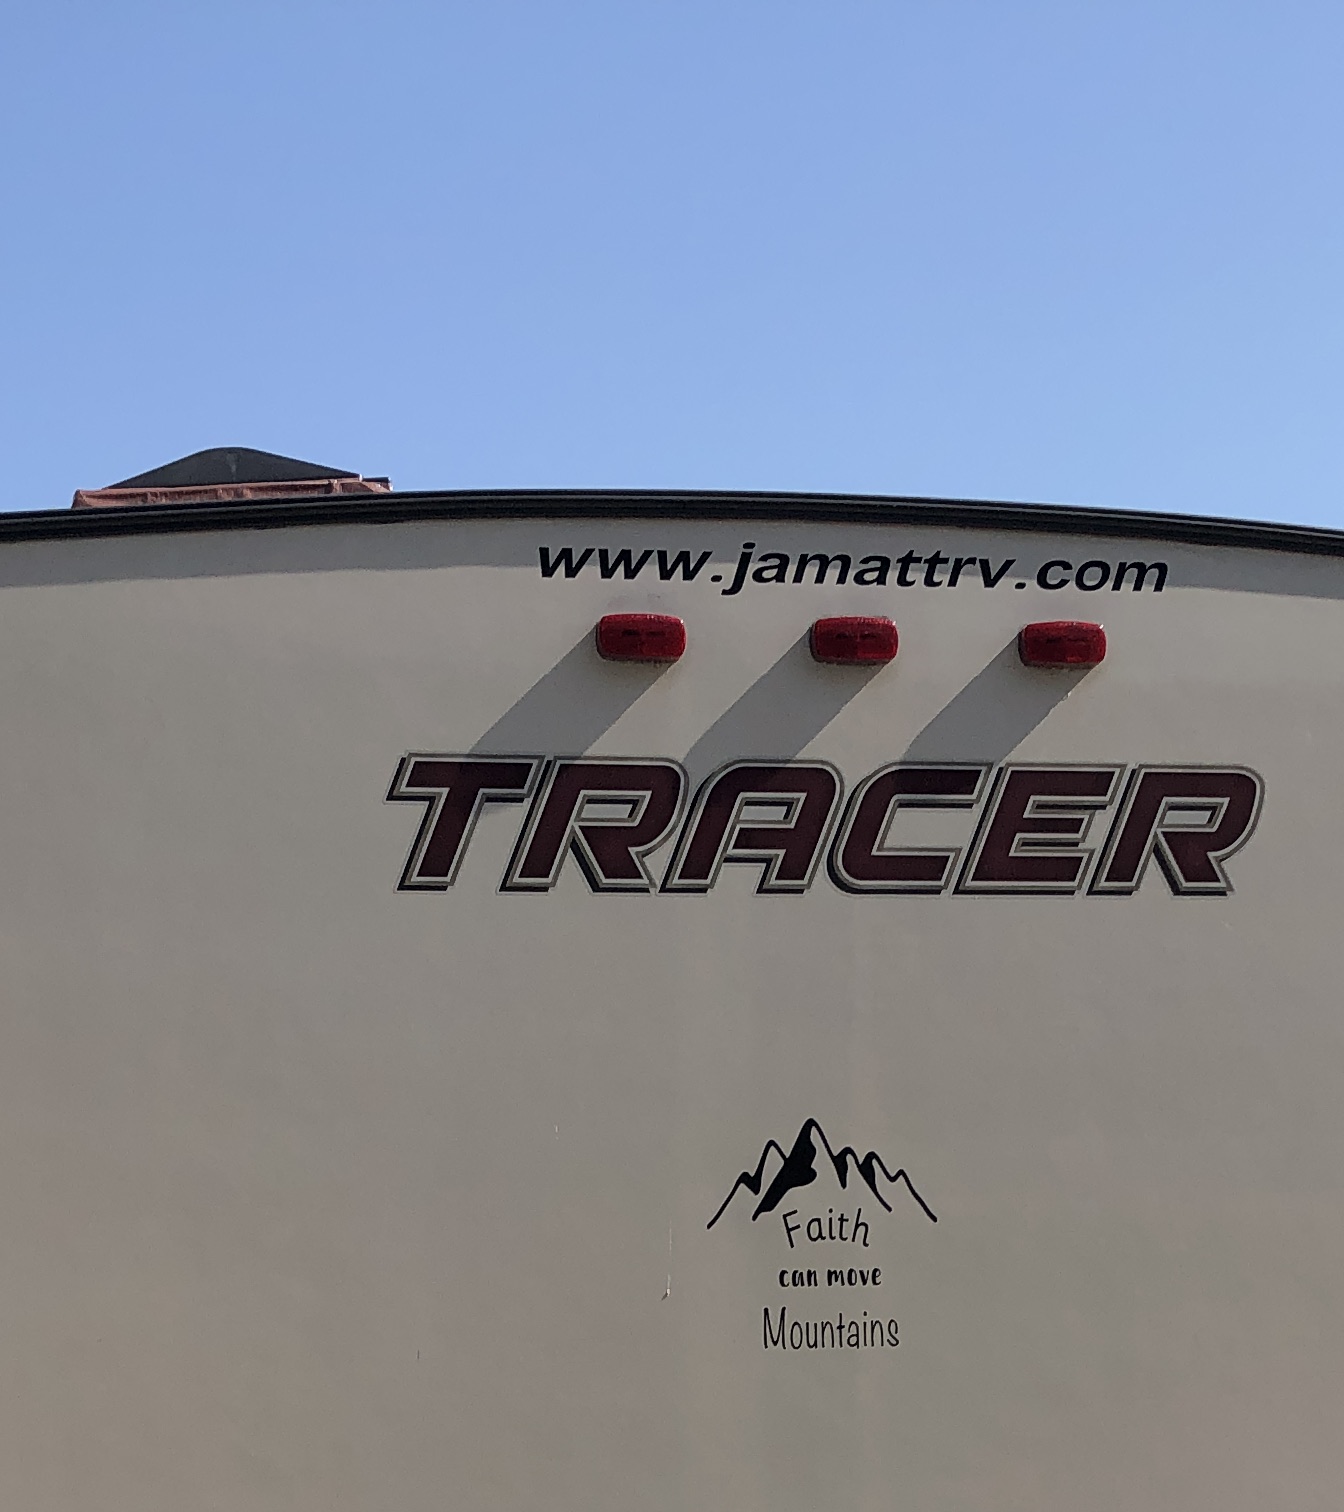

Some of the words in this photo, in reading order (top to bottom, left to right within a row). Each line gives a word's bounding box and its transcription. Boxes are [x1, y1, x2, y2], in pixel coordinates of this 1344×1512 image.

[538, 541, 1168, 596] www.jamattrv.com
[385, 751, 1265, 897] TRACER
[782, 1208, 870, 1248] Faith
[778, 1268, 819, 1288] can
[827, 1267, 882, 1287] move
[763, 1306, 900, 1350] Mountains
